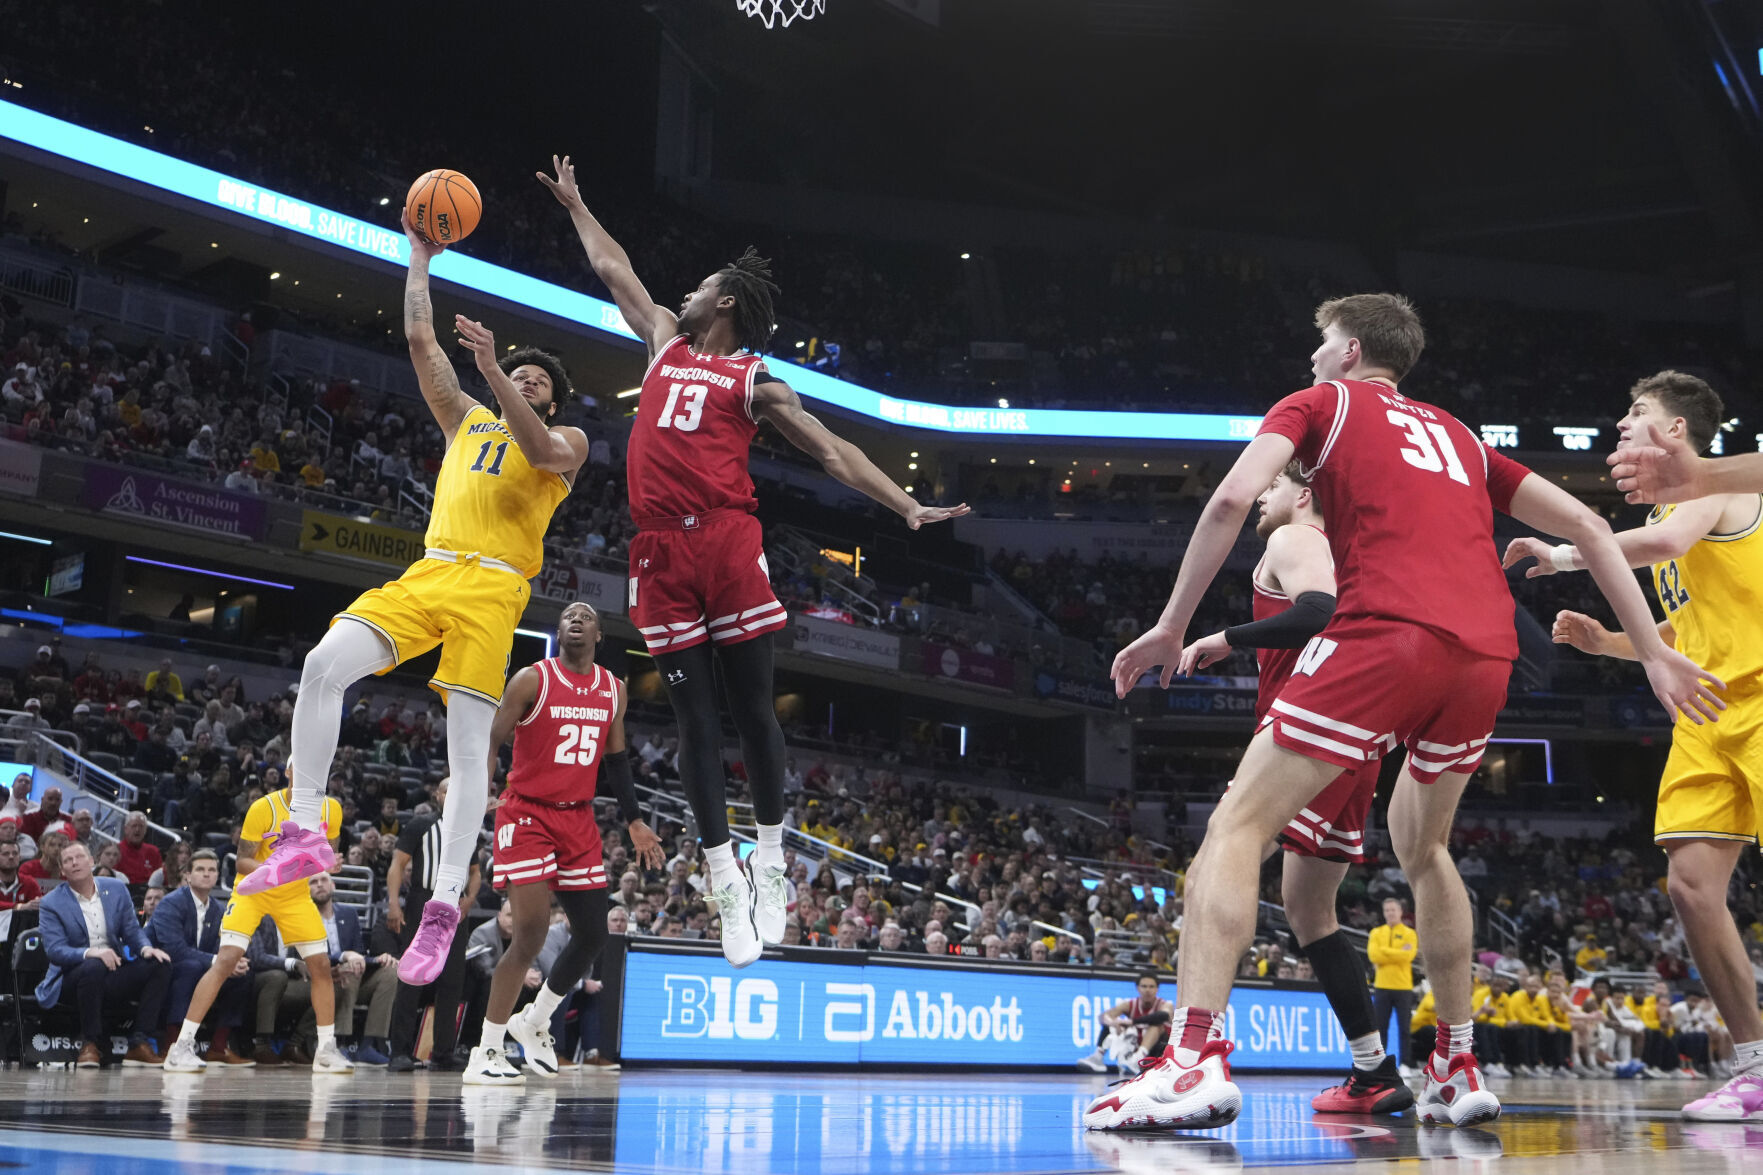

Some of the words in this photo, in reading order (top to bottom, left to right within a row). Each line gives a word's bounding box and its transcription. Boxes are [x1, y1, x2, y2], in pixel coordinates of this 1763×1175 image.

[317, 212, 357, 244] SAVE
[358, 225, 401, 259] LIVES.
[659, 364, 737, 390] WISCONSIN
[657, 382, 709, 432] 13
[953, 410, 987, 429] SAVE
[469, 440, 509, 477] 11
[1386, 409, 1471, 486] 31
[151, 502, 174, 520] St.
[176, 505, 241, 533] Vincent
[154, 481, 241, 513] Ascension
[1659, 559, 1691, 613] 42
[549, 705, 609, 722] WISCONSIN
[553, 723, 601, 767] 25
[882, 988, 1024, 1042] Abbott
[1249, 1003, 1310, 1053] SAVE
